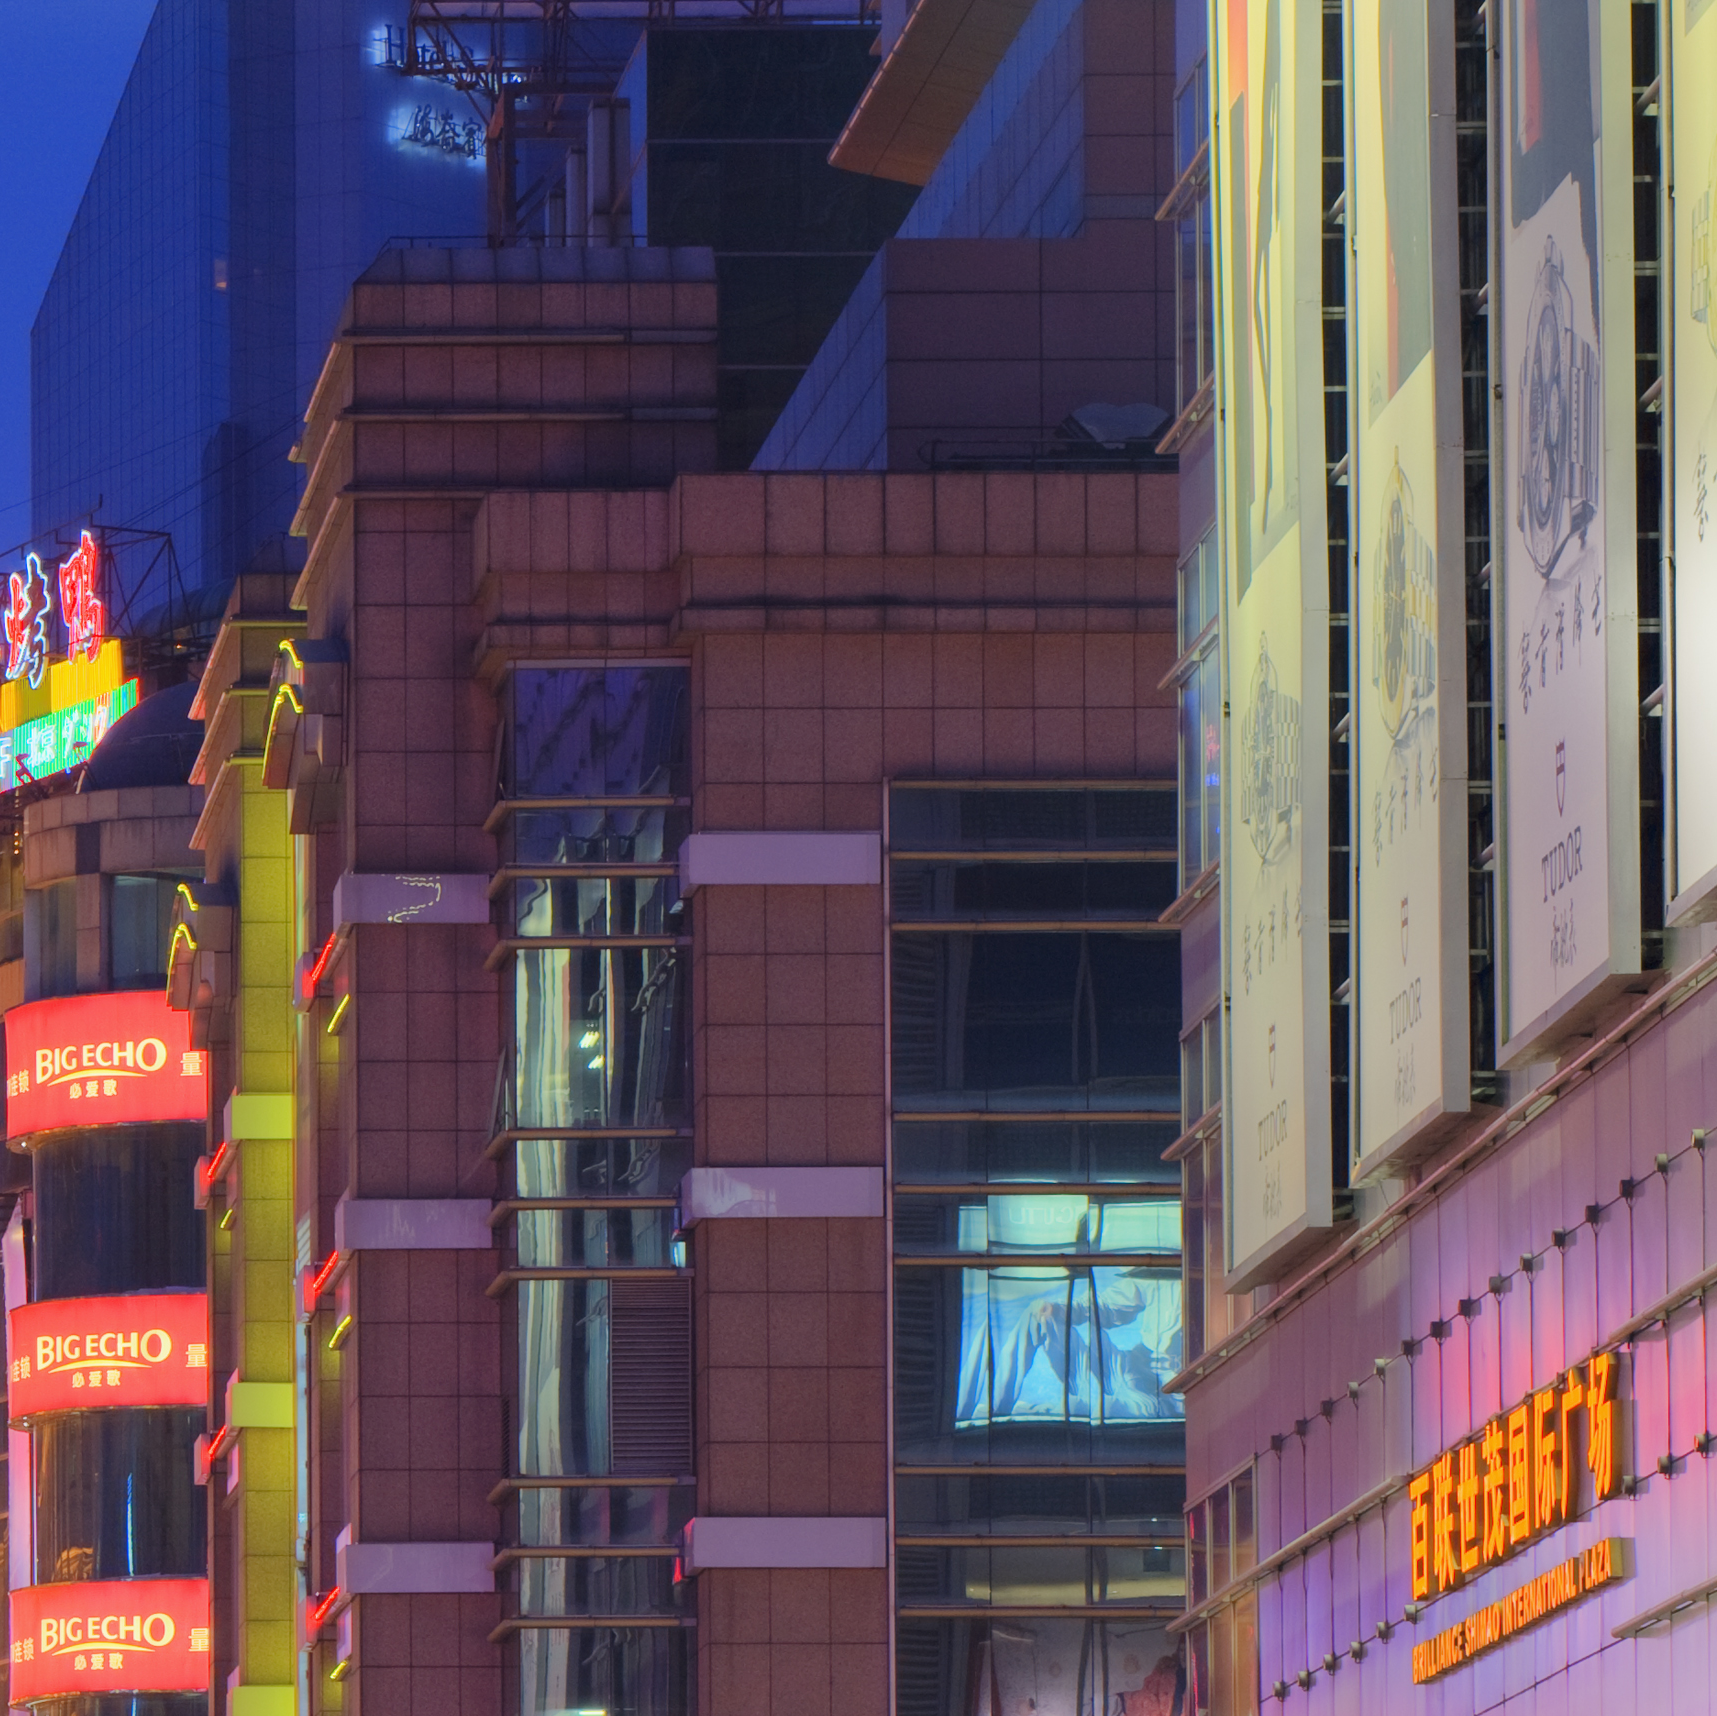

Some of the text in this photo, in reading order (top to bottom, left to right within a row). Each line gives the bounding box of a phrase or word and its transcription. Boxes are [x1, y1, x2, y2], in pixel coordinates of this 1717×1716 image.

[1542, 824, 1584, 904] TUDOR
[1388, 976, 1422, 1046] TUDOR
[35, 1037, 167, 1085] BIG ECHO
[69, 1078, 118, 1100] 必爱歌
[1257, 1099, 1288, 1163] TUDOR
[36, 1328, 173, 1371] BIG ECHO
[71, 1369, 122, 1389] 必爱歌
[1408, 1351, 1617, 1602] 百联世茂国际广场
[40, 1612, 176, 1653] BIG ECHO
[1411, 1537, 1612, 1685] BRILLIANCE SHIMAO INTERNATIONAL PLAZA
[74, 1652, 124, 1671] 必爱歌
